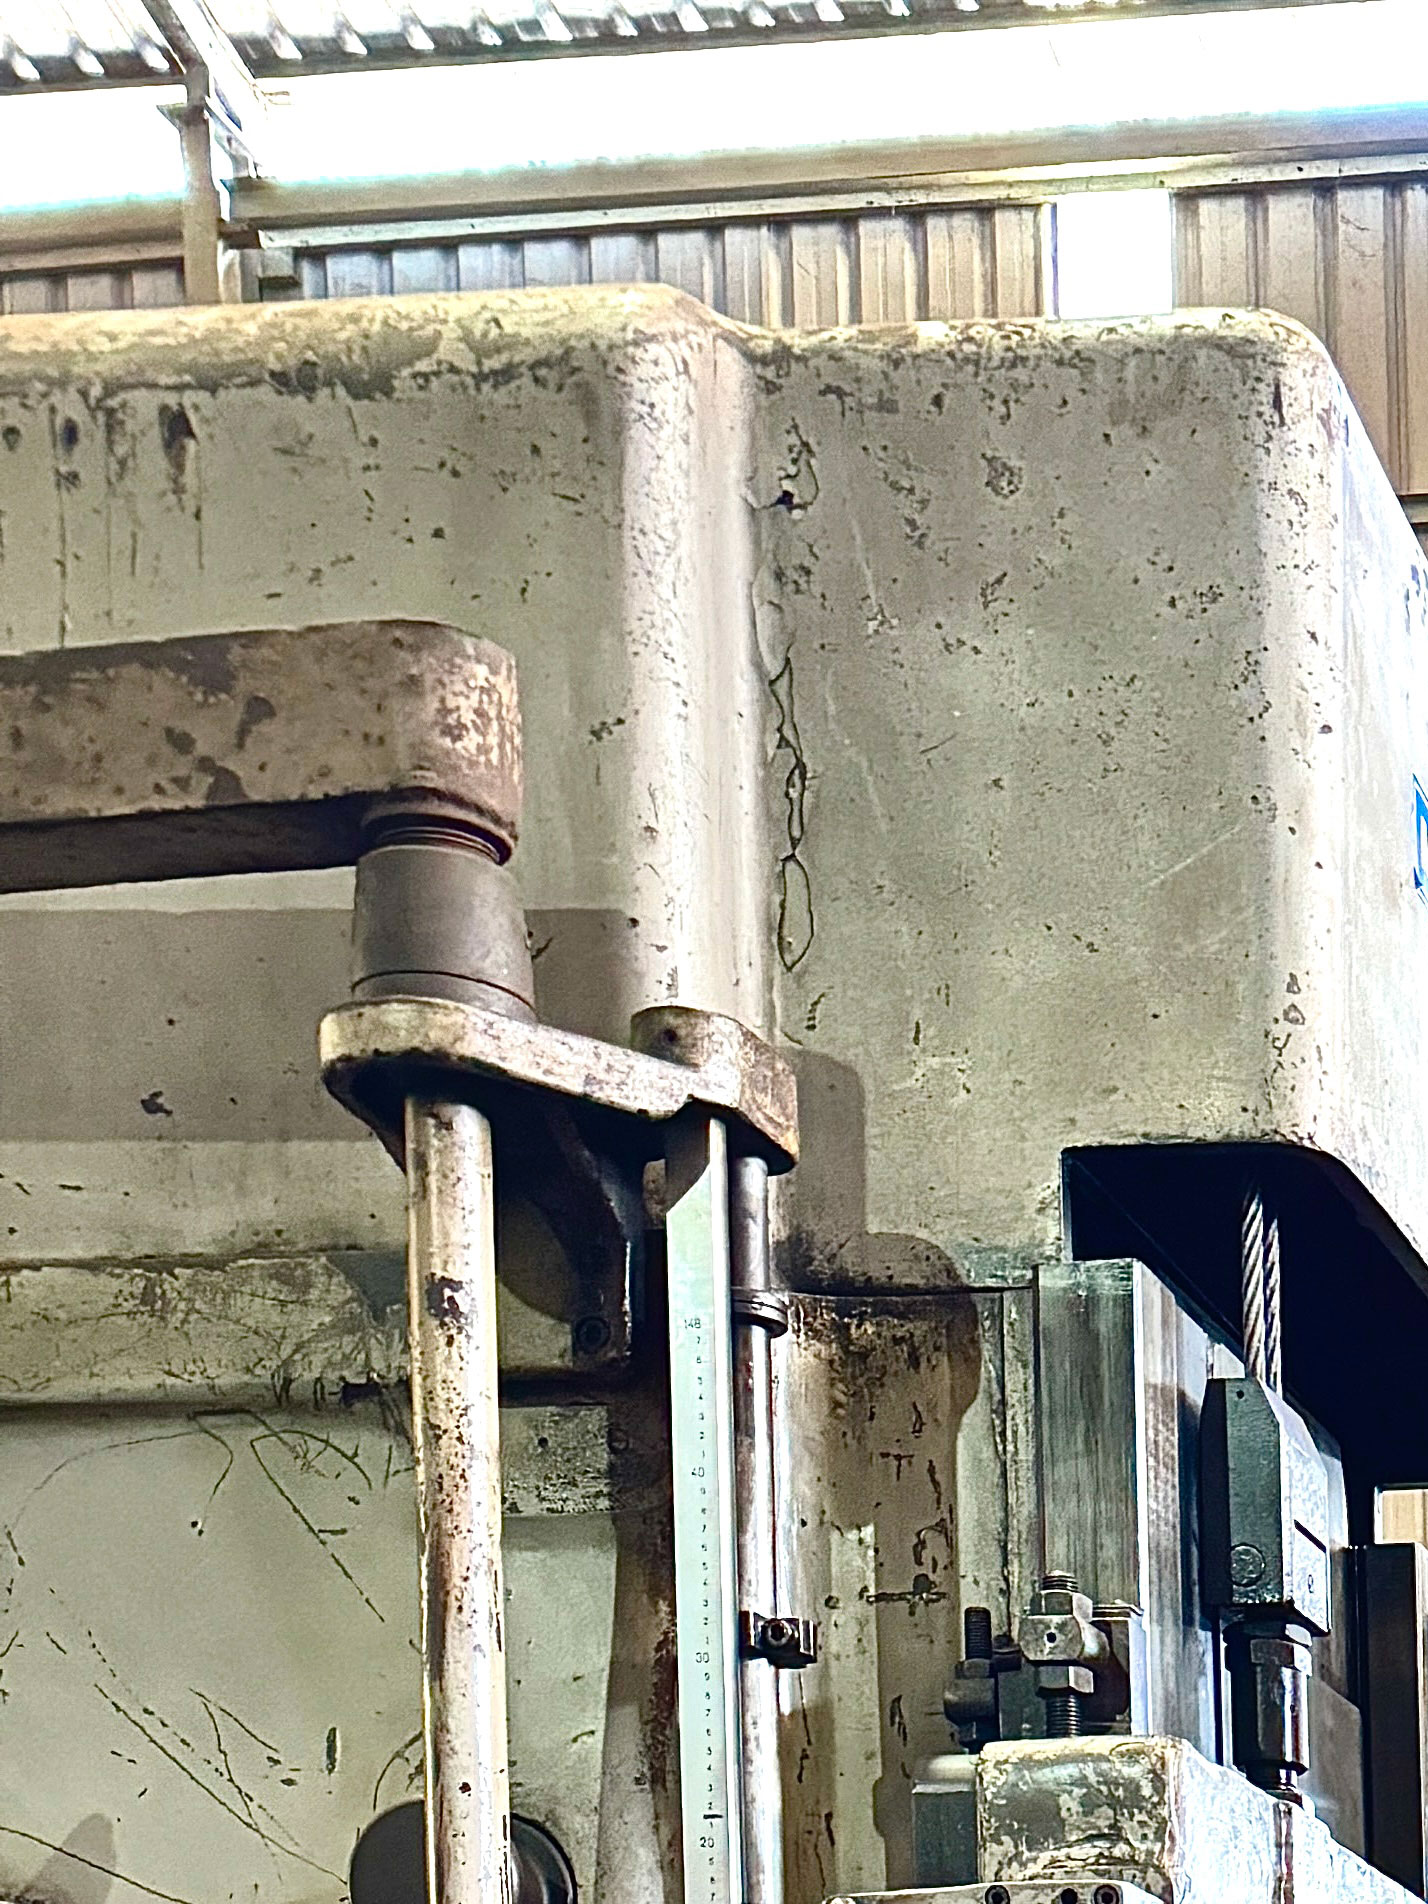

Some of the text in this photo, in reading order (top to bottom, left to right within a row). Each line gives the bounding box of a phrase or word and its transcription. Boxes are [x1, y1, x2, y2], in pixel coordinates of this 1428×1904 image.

[683, 1317, 702, 1331] 148
[695, 1651, 710, 1664] 30
[699, 1835, 715, 1849] 20
